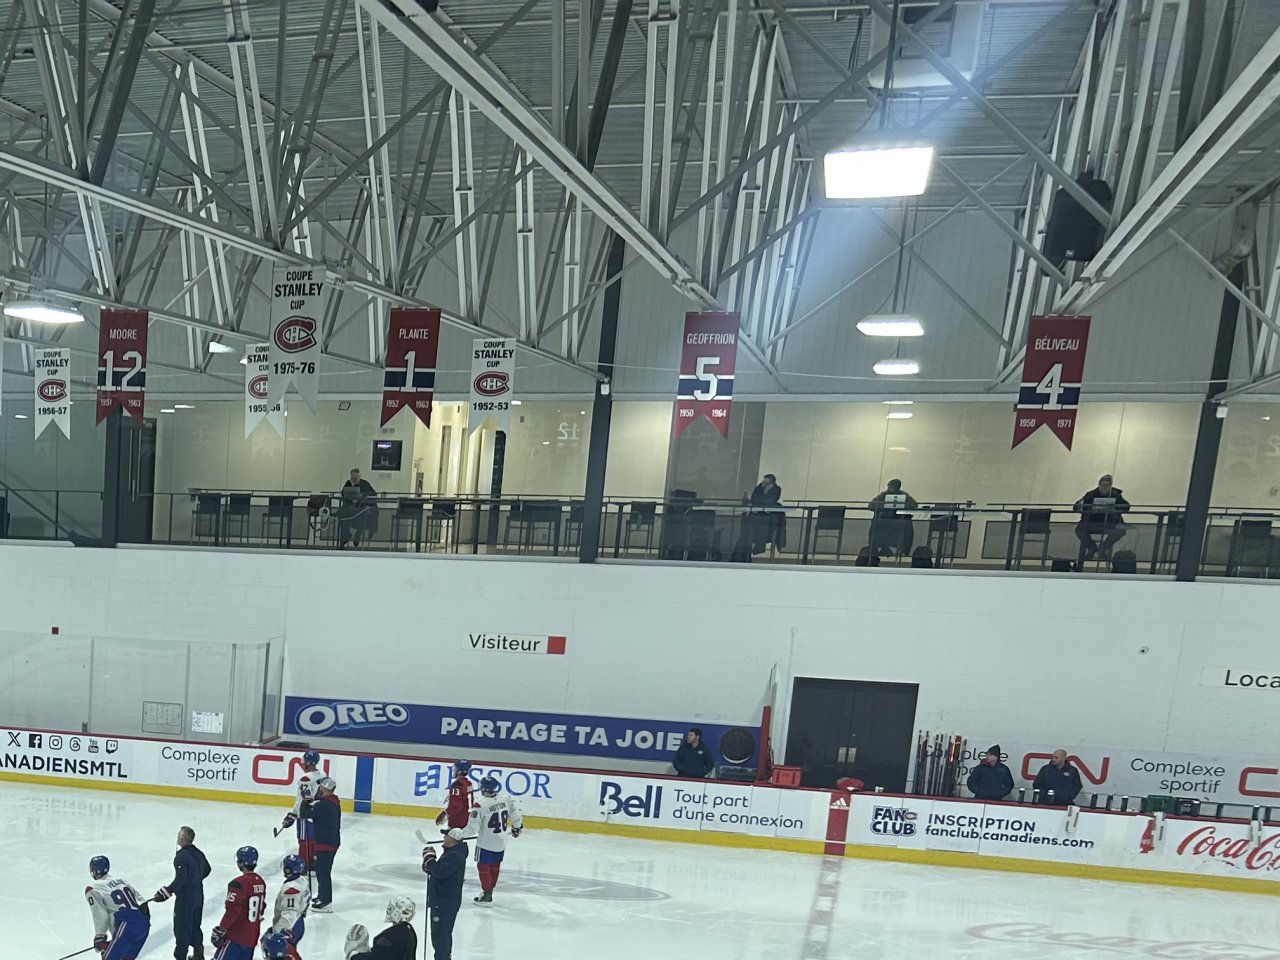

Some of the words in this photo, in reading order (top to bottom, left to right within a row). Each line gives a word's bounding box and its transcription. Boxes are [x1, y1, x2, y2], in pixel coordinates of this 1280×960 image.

[286, 270, 313, 281] COUPE
[275, 282, 323, 298] STANLEY
[290, 300, 305, 310] CUP
[109, 329, 138, 340] MOORE
[399, 328, 429, 340] PLANTE
[686, 333, 735, 345] GEOFFRION
[483, 341, 506, 349] COUPE
[1034, 335, 1079, 351] BÉLIVEAU
[247, 354, 268, 363] STAN
[474, 349, 515, 359] STANLEY
[36, 359, 69, 368] STANLEY
[102, 350, 143, 392] 12
[273, 362, 315, 375] 1975-76
[399, 350, 417, 393] 1
[693, 356, 720, 401] 5
[1035, 363, 1064, 411] 4
[38, 407, 67, 415] 1956-57
[472, 401, 509, 411] 1952-53
[679, 409, 694, 417] 1950
[1019, 418, 1036, 427] 1950
[1057, 418, 1071, 428] 1971
[469, 633, 540, 652] Visiteur
[297, 702, 409, 734] OREO
[440, 716, 566, 744] PARTAGE
[574, 725, 609, 747] TA
[615, 729, 684, 752] JOIE
[161, 746, 240, 766] Complexe
[187, 766, 238, 781] sportif
[1130, 758, 1225, 777] Complexe
[1159, 779, 1221, 793] sportif
[599, 781, 663, 819] Bell
[674, 788, 708, 805] Tout
[713, 796, 749, 808] part
[487, 810, 509, 834] 48
[673, 806, 715, 821] d'une
[720, 813, 803, 829] connexion
[873, 807, 907, 822] FAN
[871, 820, 915, 836] CLUB
[928, 813, 1036, 832] INSCRIPTION
[925, 825, 1094, 849] fanclub.canadiens.com
[286, 898, 295, 908] 11
